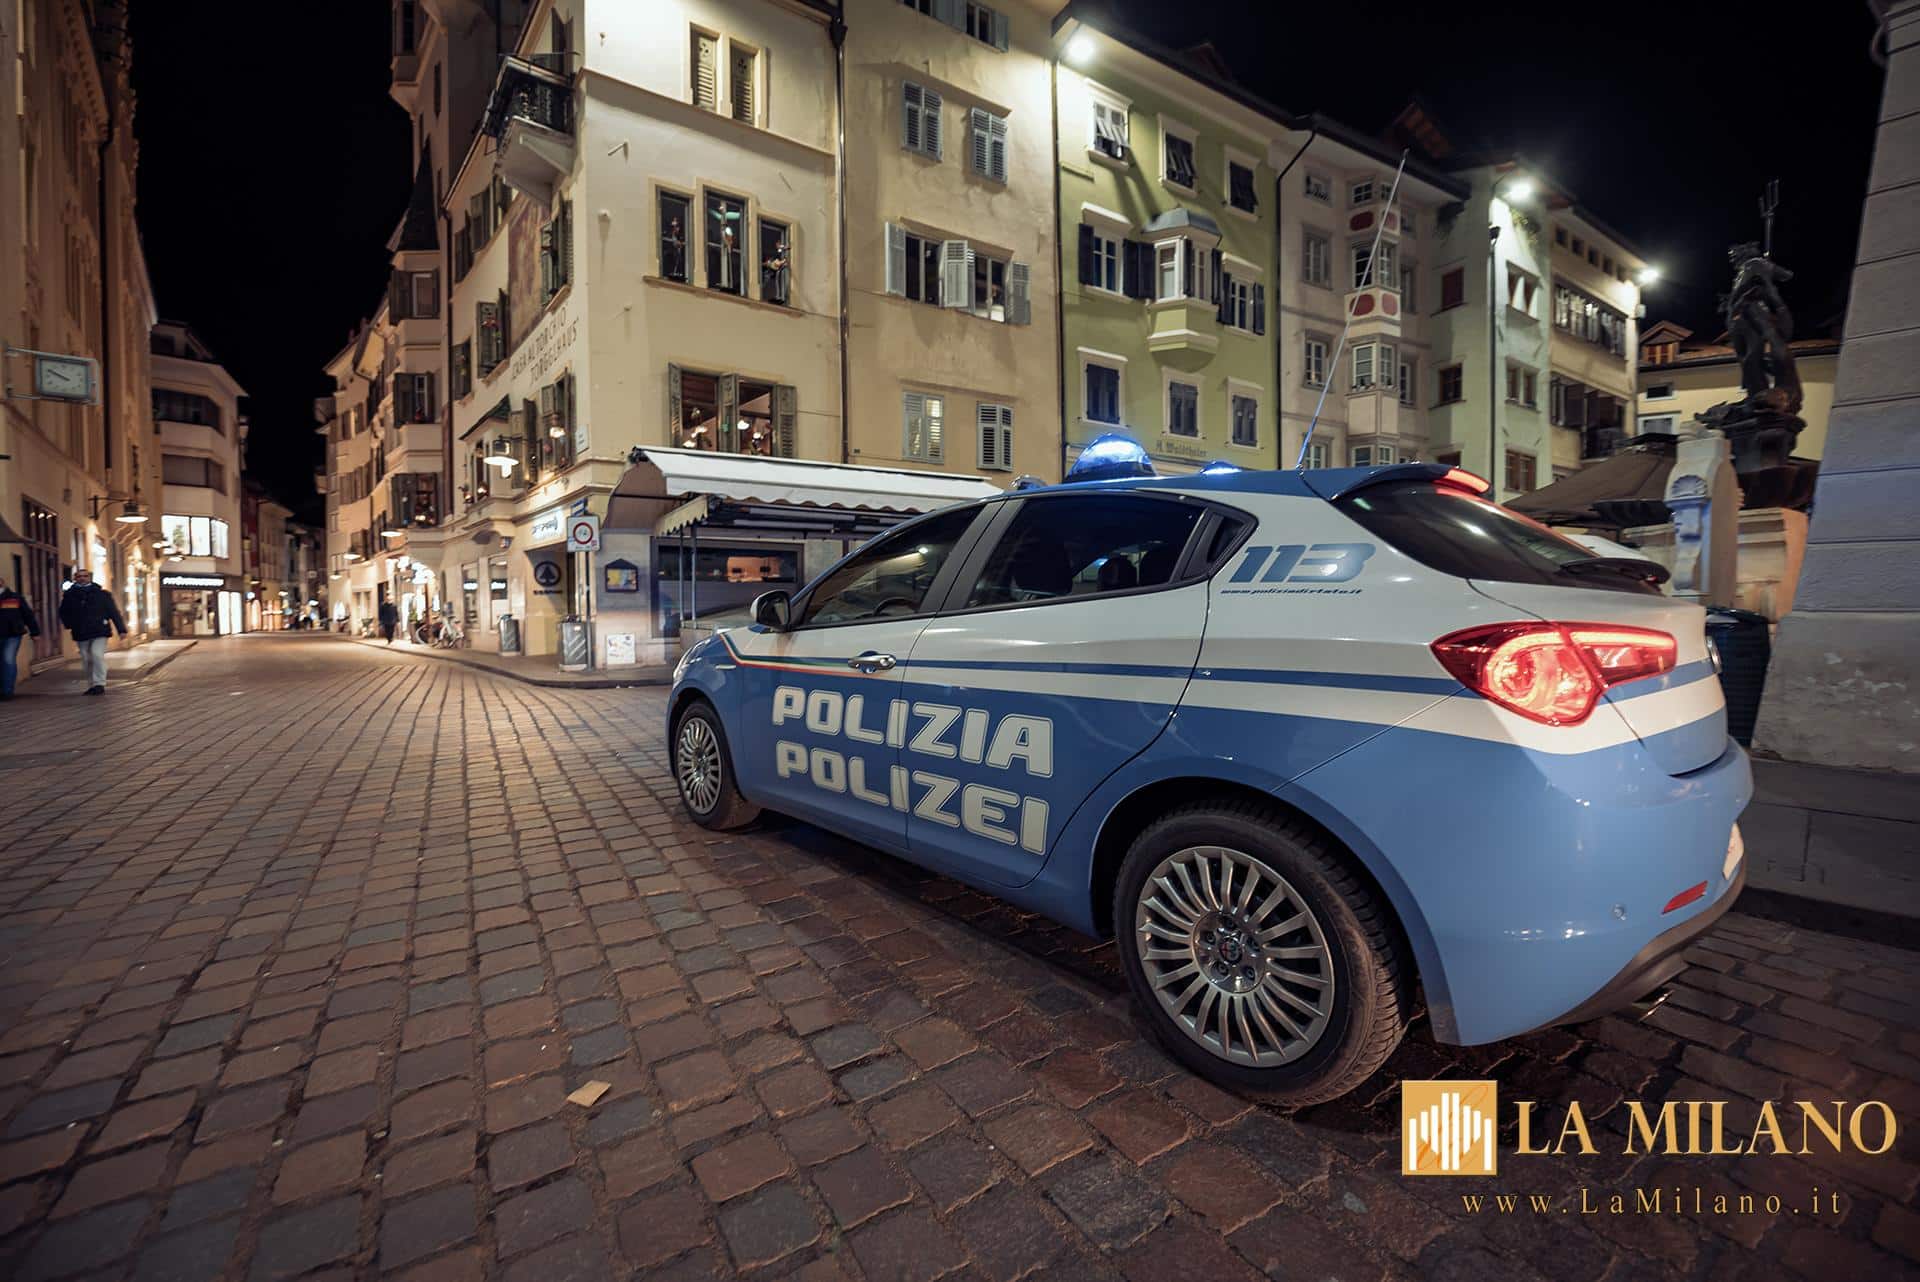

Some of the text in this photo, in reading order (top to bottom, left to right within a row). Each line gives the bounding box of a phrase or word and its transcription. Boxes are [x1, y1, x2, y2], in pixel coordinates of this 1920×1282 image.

[1229, 543, 1376, 583] 113
[772, 685, 1053, 777] POLIZIA
[776, 740, 1050, 855] POLIZEI
